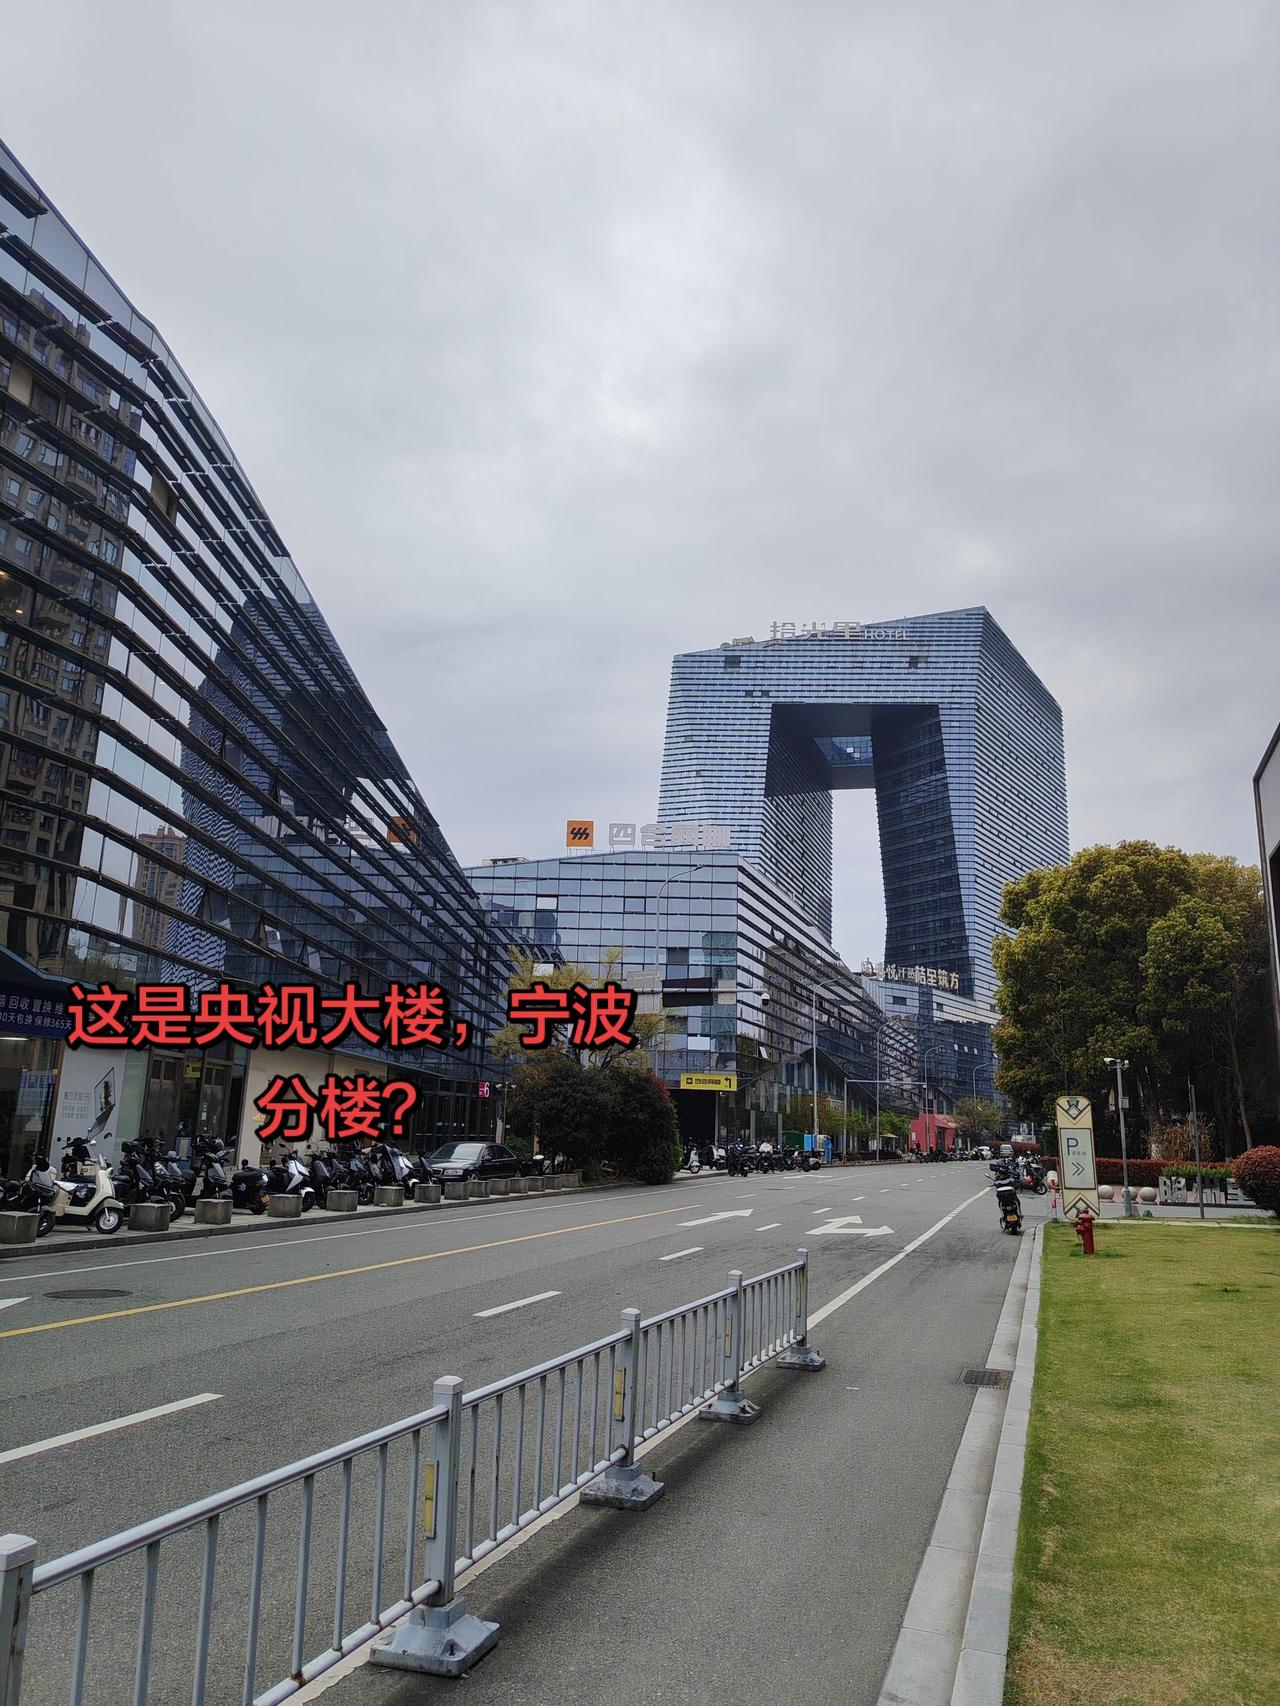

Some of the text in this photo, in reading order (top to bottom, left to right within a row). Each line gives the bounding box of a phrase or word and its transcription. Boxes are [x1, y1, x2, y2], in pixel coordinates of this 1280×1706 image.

[770, 620, 908, 641] 拾光里 HOTEL
[8, 995, 30, 1011] 回收
[34, 1015, 72, 1030] 保修365天
[1066, 1137, 1079, 1156] P
